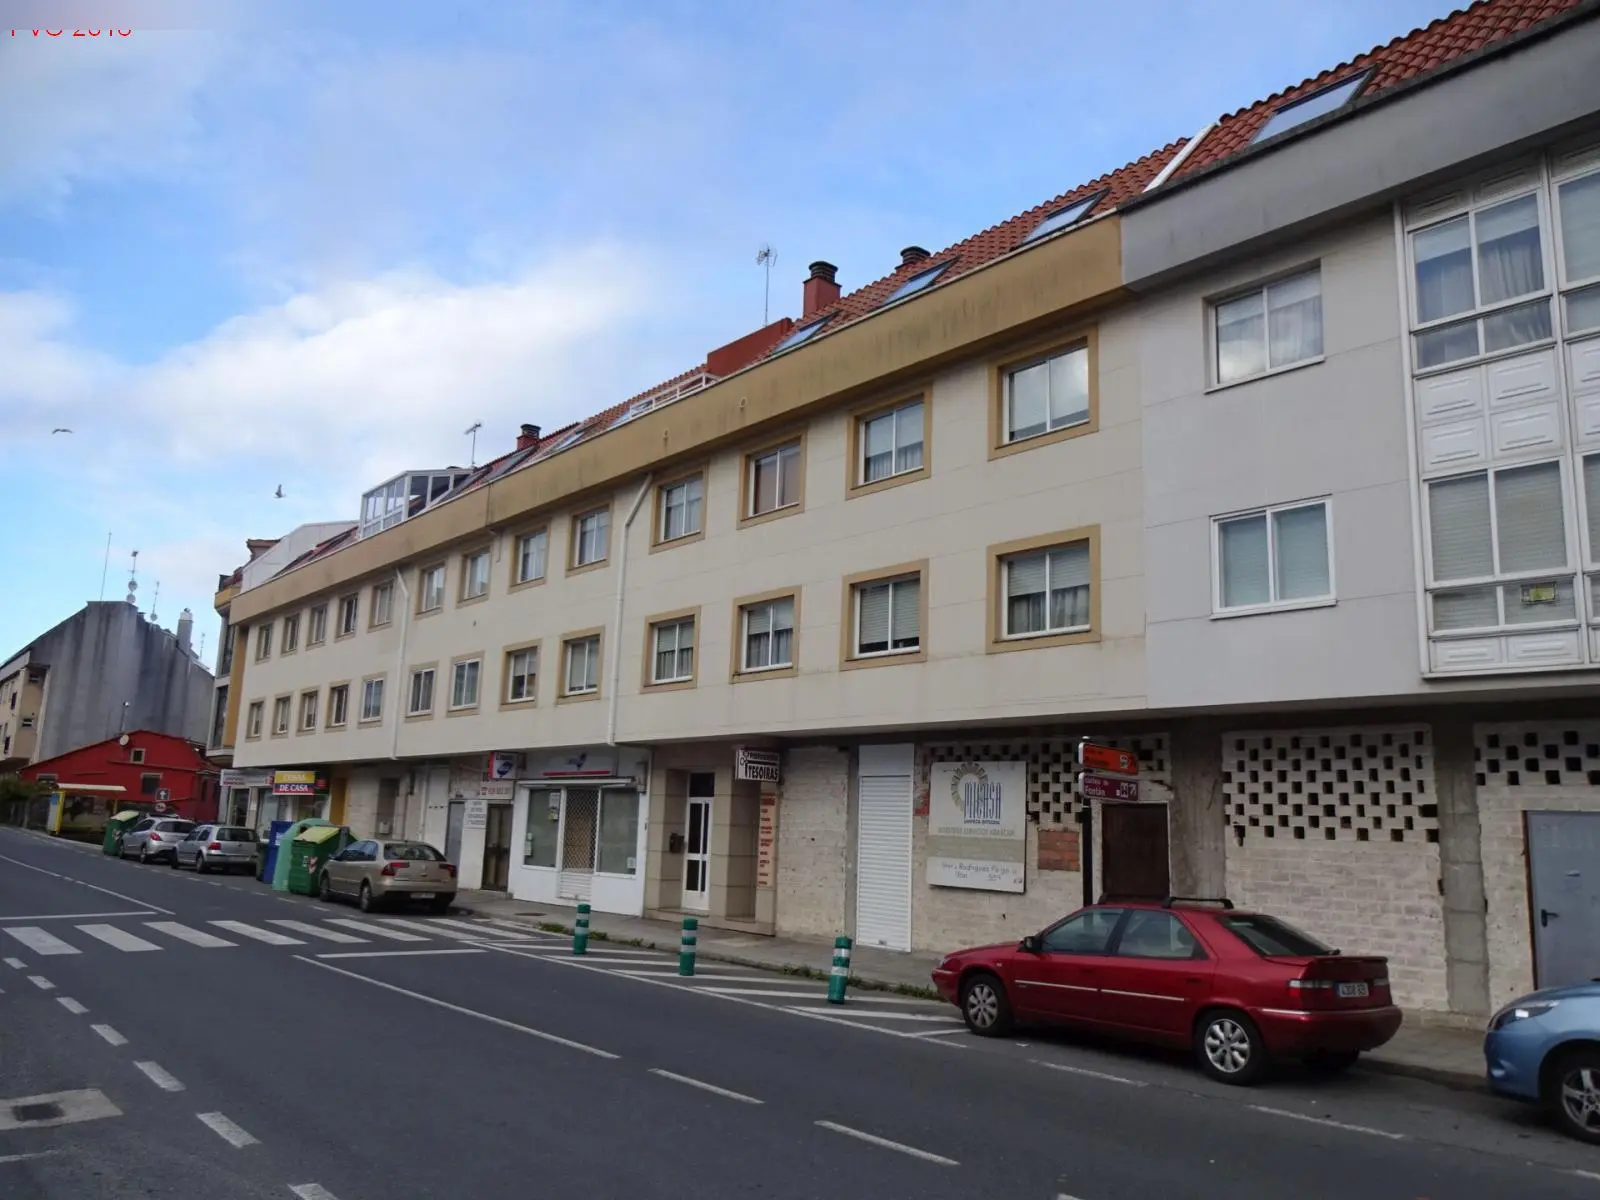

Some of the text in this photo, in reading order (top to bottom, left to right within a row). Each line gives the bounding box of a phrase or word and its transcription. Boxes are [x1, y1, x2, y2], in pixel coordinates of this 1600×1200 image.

[748, 765, 778, 780] TESOIRAS
[279, 784, 309, 792] DE CASA
